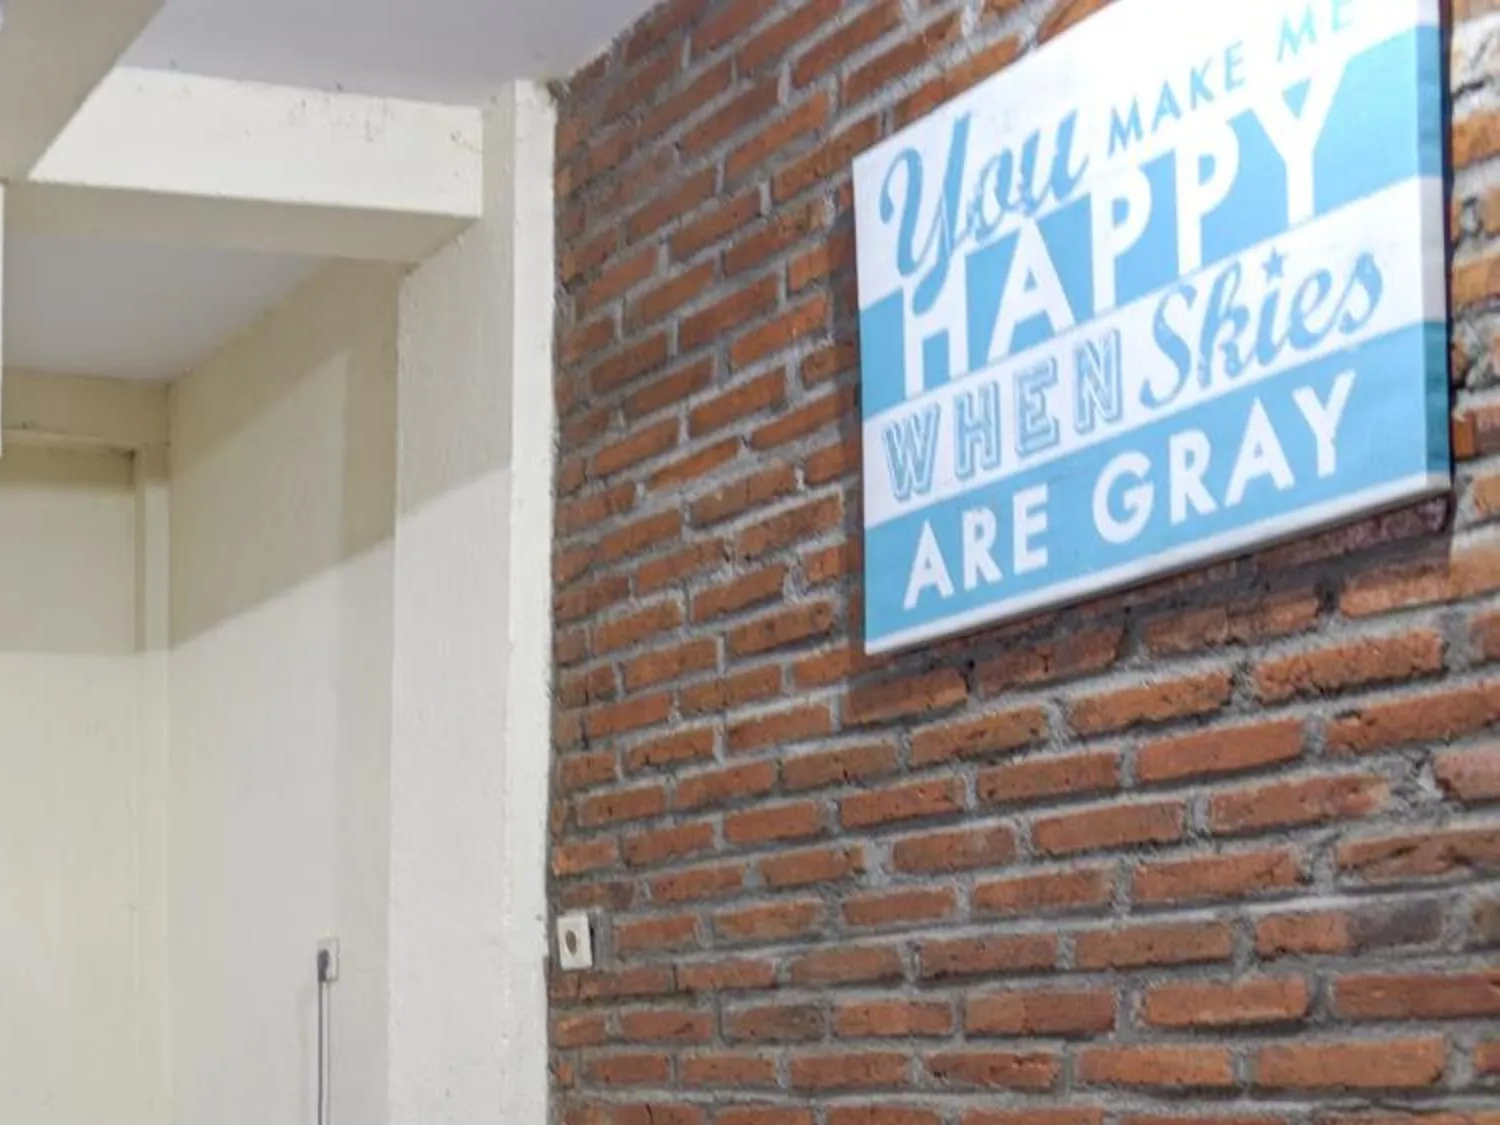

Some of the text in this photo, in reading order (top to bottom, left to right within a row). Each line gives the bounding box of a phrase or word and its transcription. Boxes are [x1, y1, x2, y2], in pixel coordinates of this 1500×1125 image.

[880, 0, 1355, 317] You MAKE ME
[902, 57, 1350, 400] HAPPY
[883, 247, 1384, 501] WHEN Skies
[903, 370, 1357, 610] ARE GRAY
